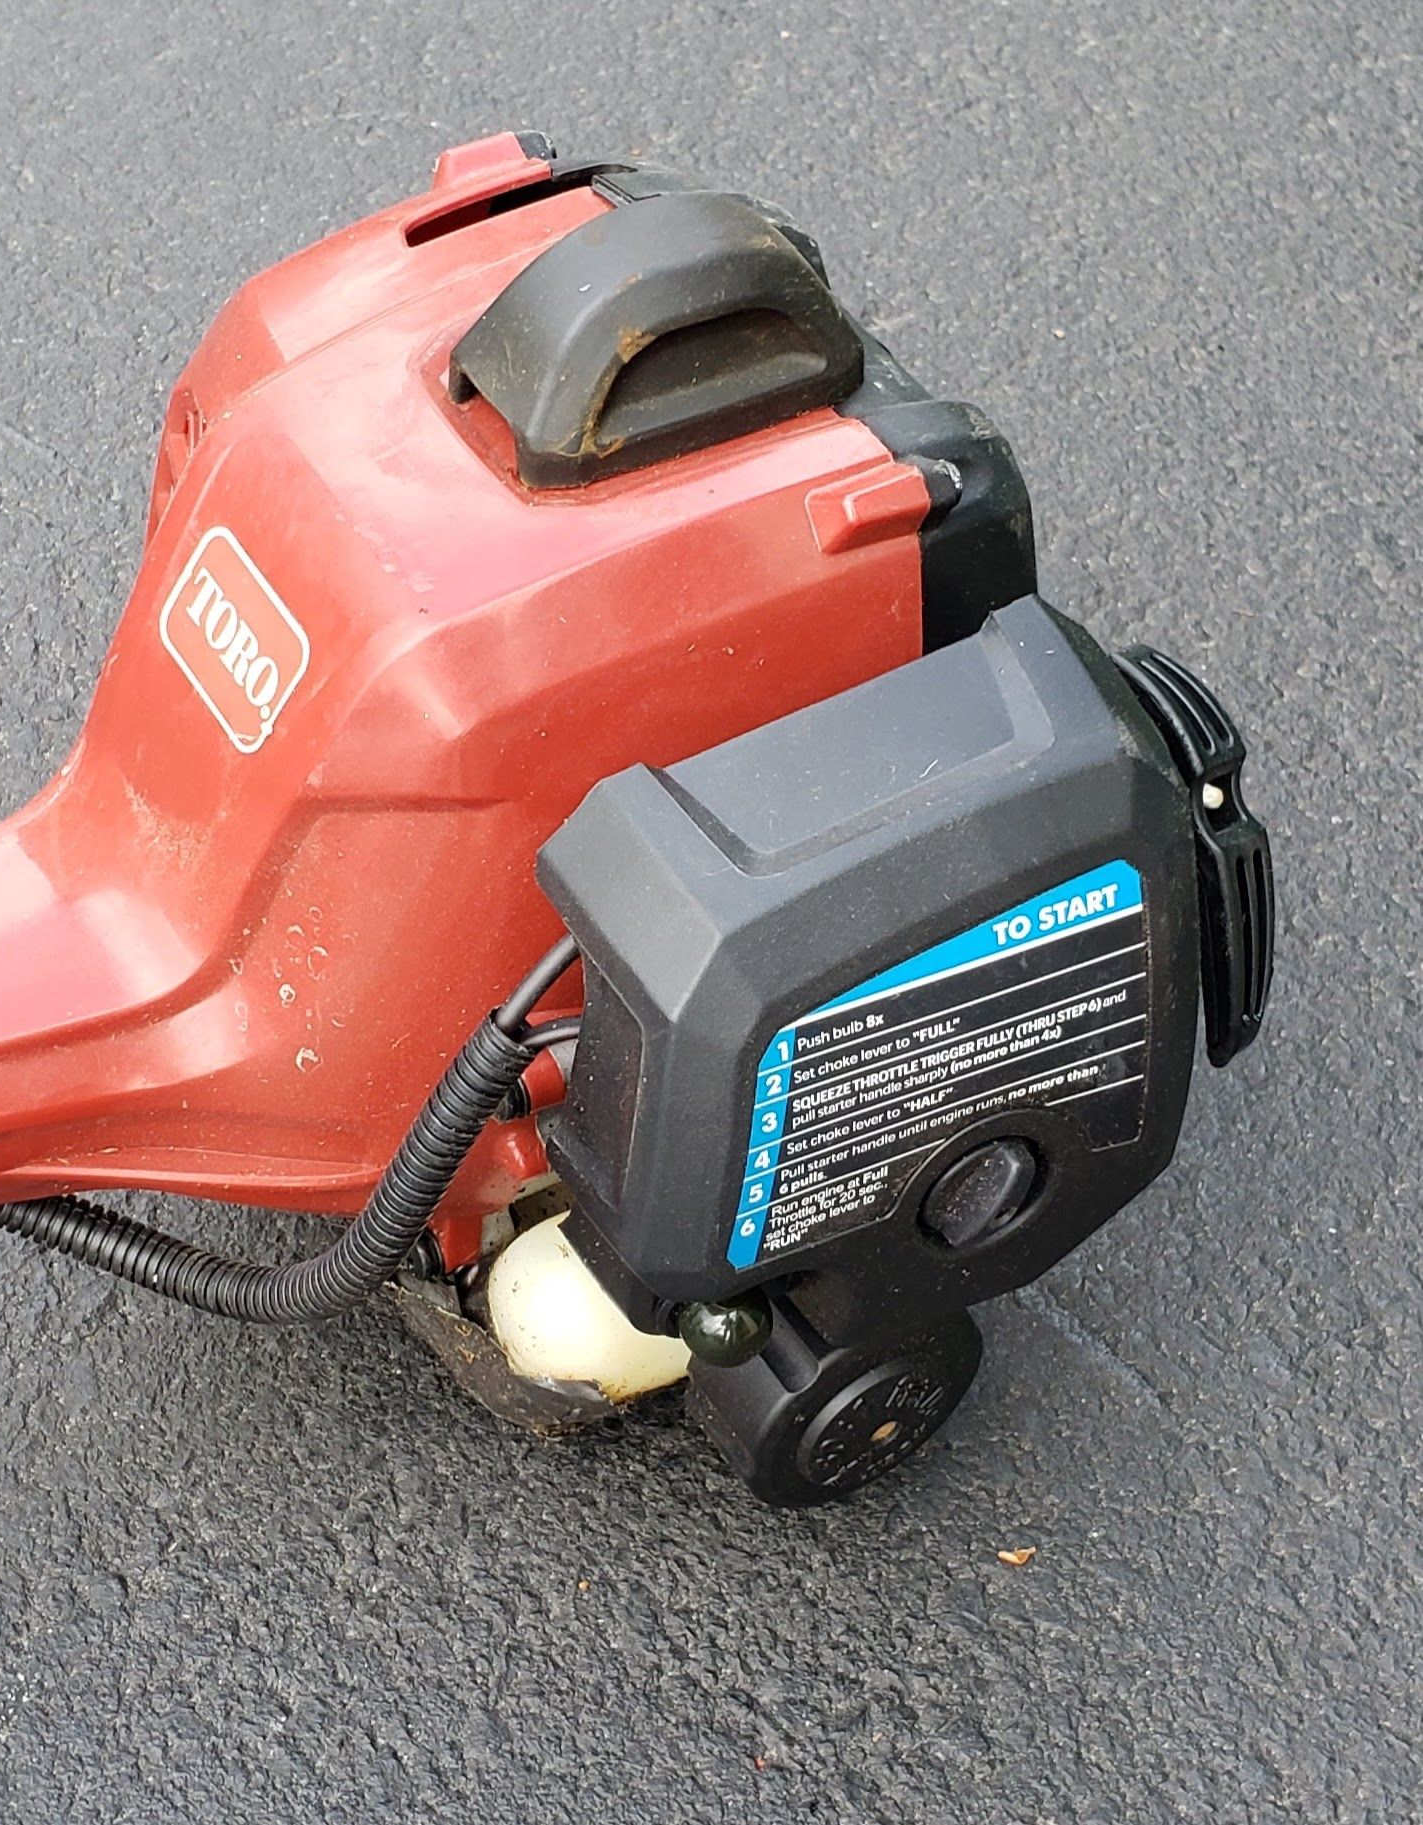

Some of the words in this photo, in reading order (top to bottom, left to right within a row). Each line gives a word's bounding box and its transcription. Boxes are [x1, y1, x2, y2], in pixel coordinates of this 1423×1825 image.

[992, 915, 1032, 946] TO
[1038, 883, 1119, 931] START
[765, 1074, 783, 1096] 2
[793, 1068, 816, 1084] Set
[817, 1053, 858, 1076] choke
[860, 1043, 893, 1062] lever
[895, 1037, 910, 1050] to
[912, 1017, 961, 1043] "FULL"
[777, 1041, 789, 1061] 1
[797, 1031, 830, 1051] Push
[833, 1020, 863, 1040] bulb
[865, 1014, 884, 1028] 8x
[792, 1082, 852, 1112] SQUEEZE
[852, 1059, 919, 1091] THROTTLE
[920, 1041, 975, 1070] TRIGGER
[977, 1027, 1015, 1051] FULLY
[1016, 1014, 1056, 1039] (THRU
[1057, 1002, 1087, 1023] STEP
[1103, 989, 1127, 1008] and
[761, 1111, 777, 1133] 3
[792, 1110, 816, 1130] pull
[817, 1095, 857, 1117] starter
[859, 1080, 902, 1104] handle
[903, 1064, 949, 1090] sharply
[950, 1058, 972, 1075] (no
[974, 1046, 1008, 1066] more
[1010, 1034, 1039, 1053] than
[1041, 1025, 1062, 1042] 4x)
[748, 1183, 764, 1204] 5
[780, 1163, 805, 1182] Pull
[807, 1148, 850, 1172] starter
[852, 1133, 896, 1157] handle
[898, 1119, 927, 1140] until
[929, 1104, 974, 1129] engine
[976, 1091, 1007, 1112] runs,
[1007, 1086, 1026, 1101] no
[1028, 1075, 1064, 1094] more
[1067, 1062, 1099, 1082] than
[754, 1150, 771, 1169] 4
[787, 1140, 808, 1155] Set
[811, 1124, 850, 1147] choke
[852, 1113, 884, 1132] lever
[887, 1107, 901, 1120] to
[903, 1086, 954, 1112] "HALF"
[740, 1218, 756, 1238] 6
[771, 1201, 799, 1218] Run
[805, 1184, 845, 1208] engine
[847, 1177, 860, 1190] at
[862, 1165, 889, 1182] Full
[769, 1206, 817, 1229] Throttle
[818, 1194, 837, 1211] for
[839, 1189, 856, 1204] 20
[779, 1183, 789, 1195] 6
[790, 1171, 828, 1193] pulls.
[763, 1229, 809, 1252] "RUN"
[765, 1228, 786, 1242] set
[787, 1210, 827, 1234] choke
[829, 1199, 861, 1218] lever
[863, 1194, 876, 1206] to
